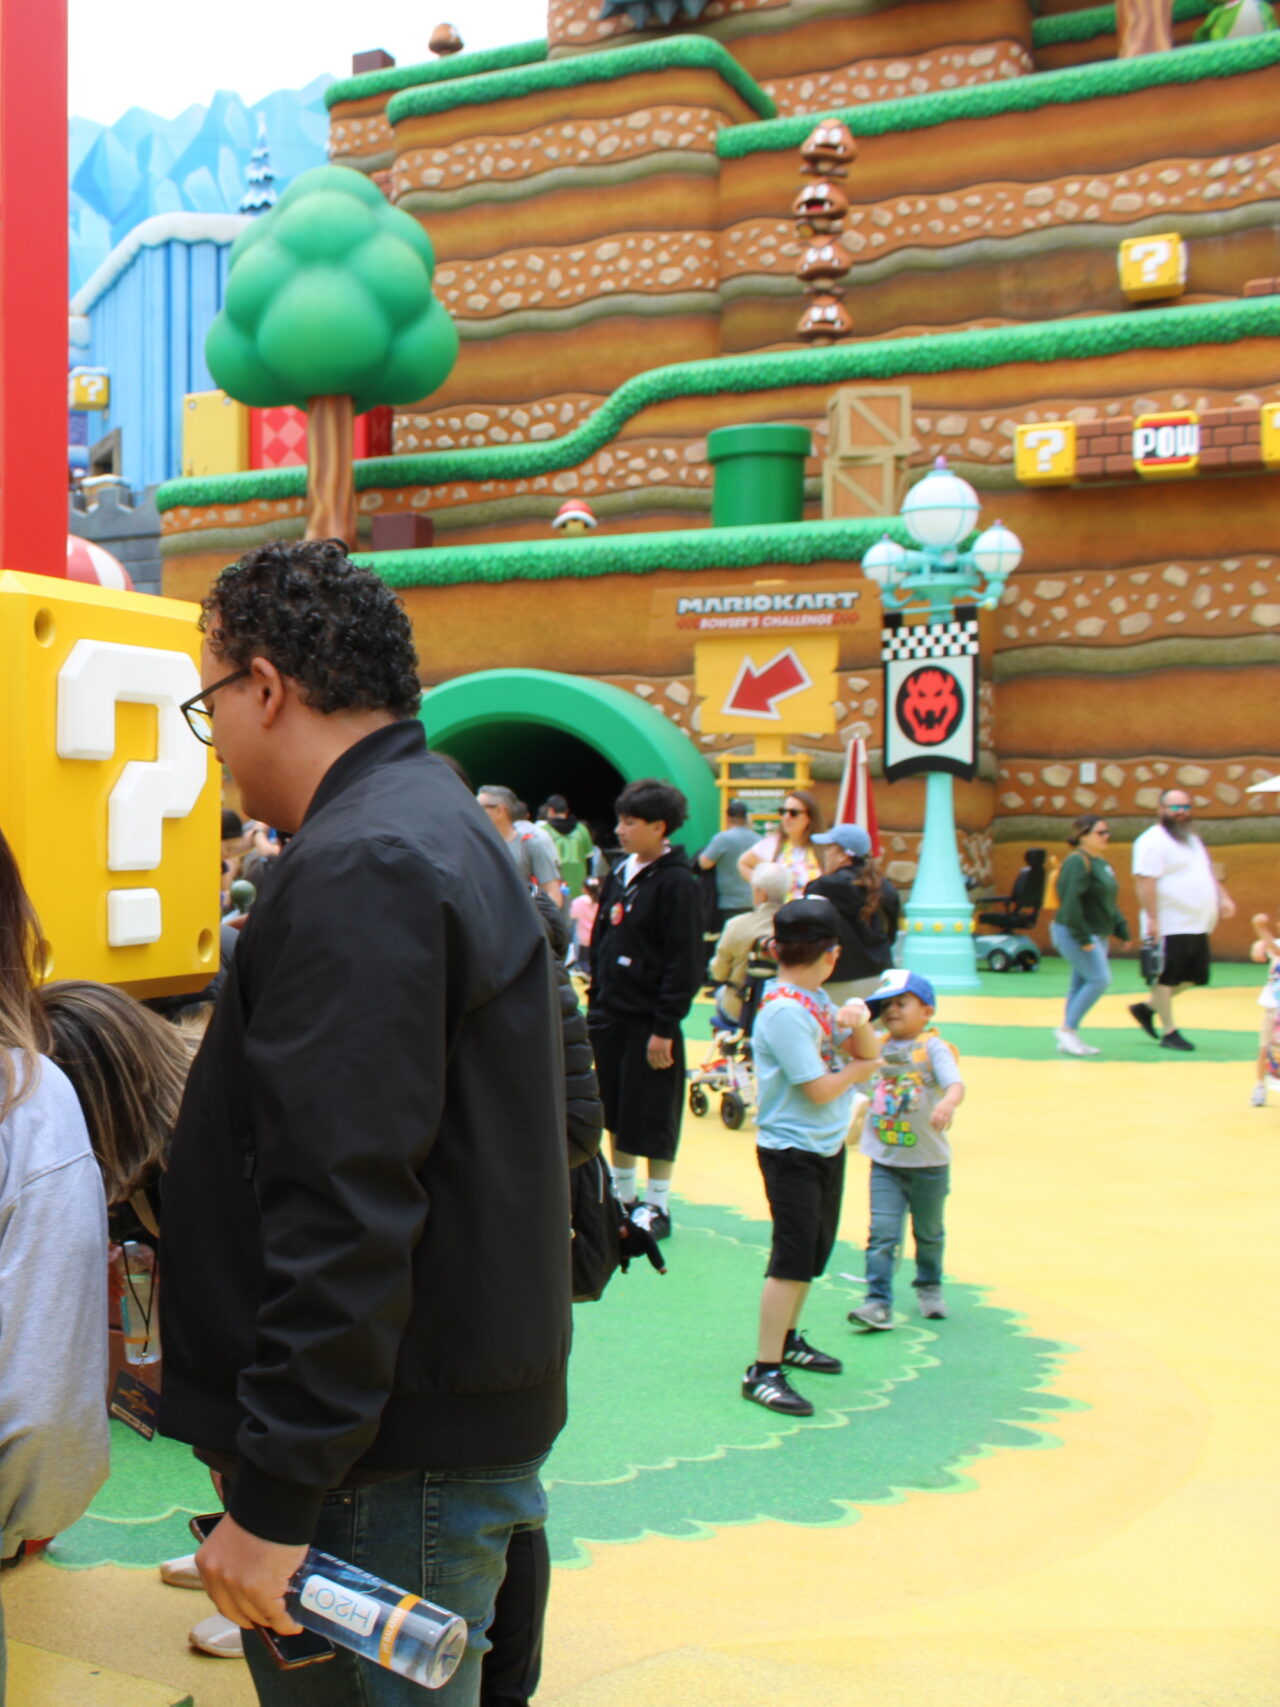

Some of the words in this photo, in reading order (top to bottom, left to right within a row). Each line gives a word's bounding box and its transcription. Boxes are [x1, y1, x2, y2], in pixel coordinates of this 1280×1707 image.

[1133, 424, 1200, 459] POW
[699, 616, 760, 630] BOWSER'S
[761, 613, 834, 628] CHALLENGE
[874, 1128, 918, 1147] ARIO
